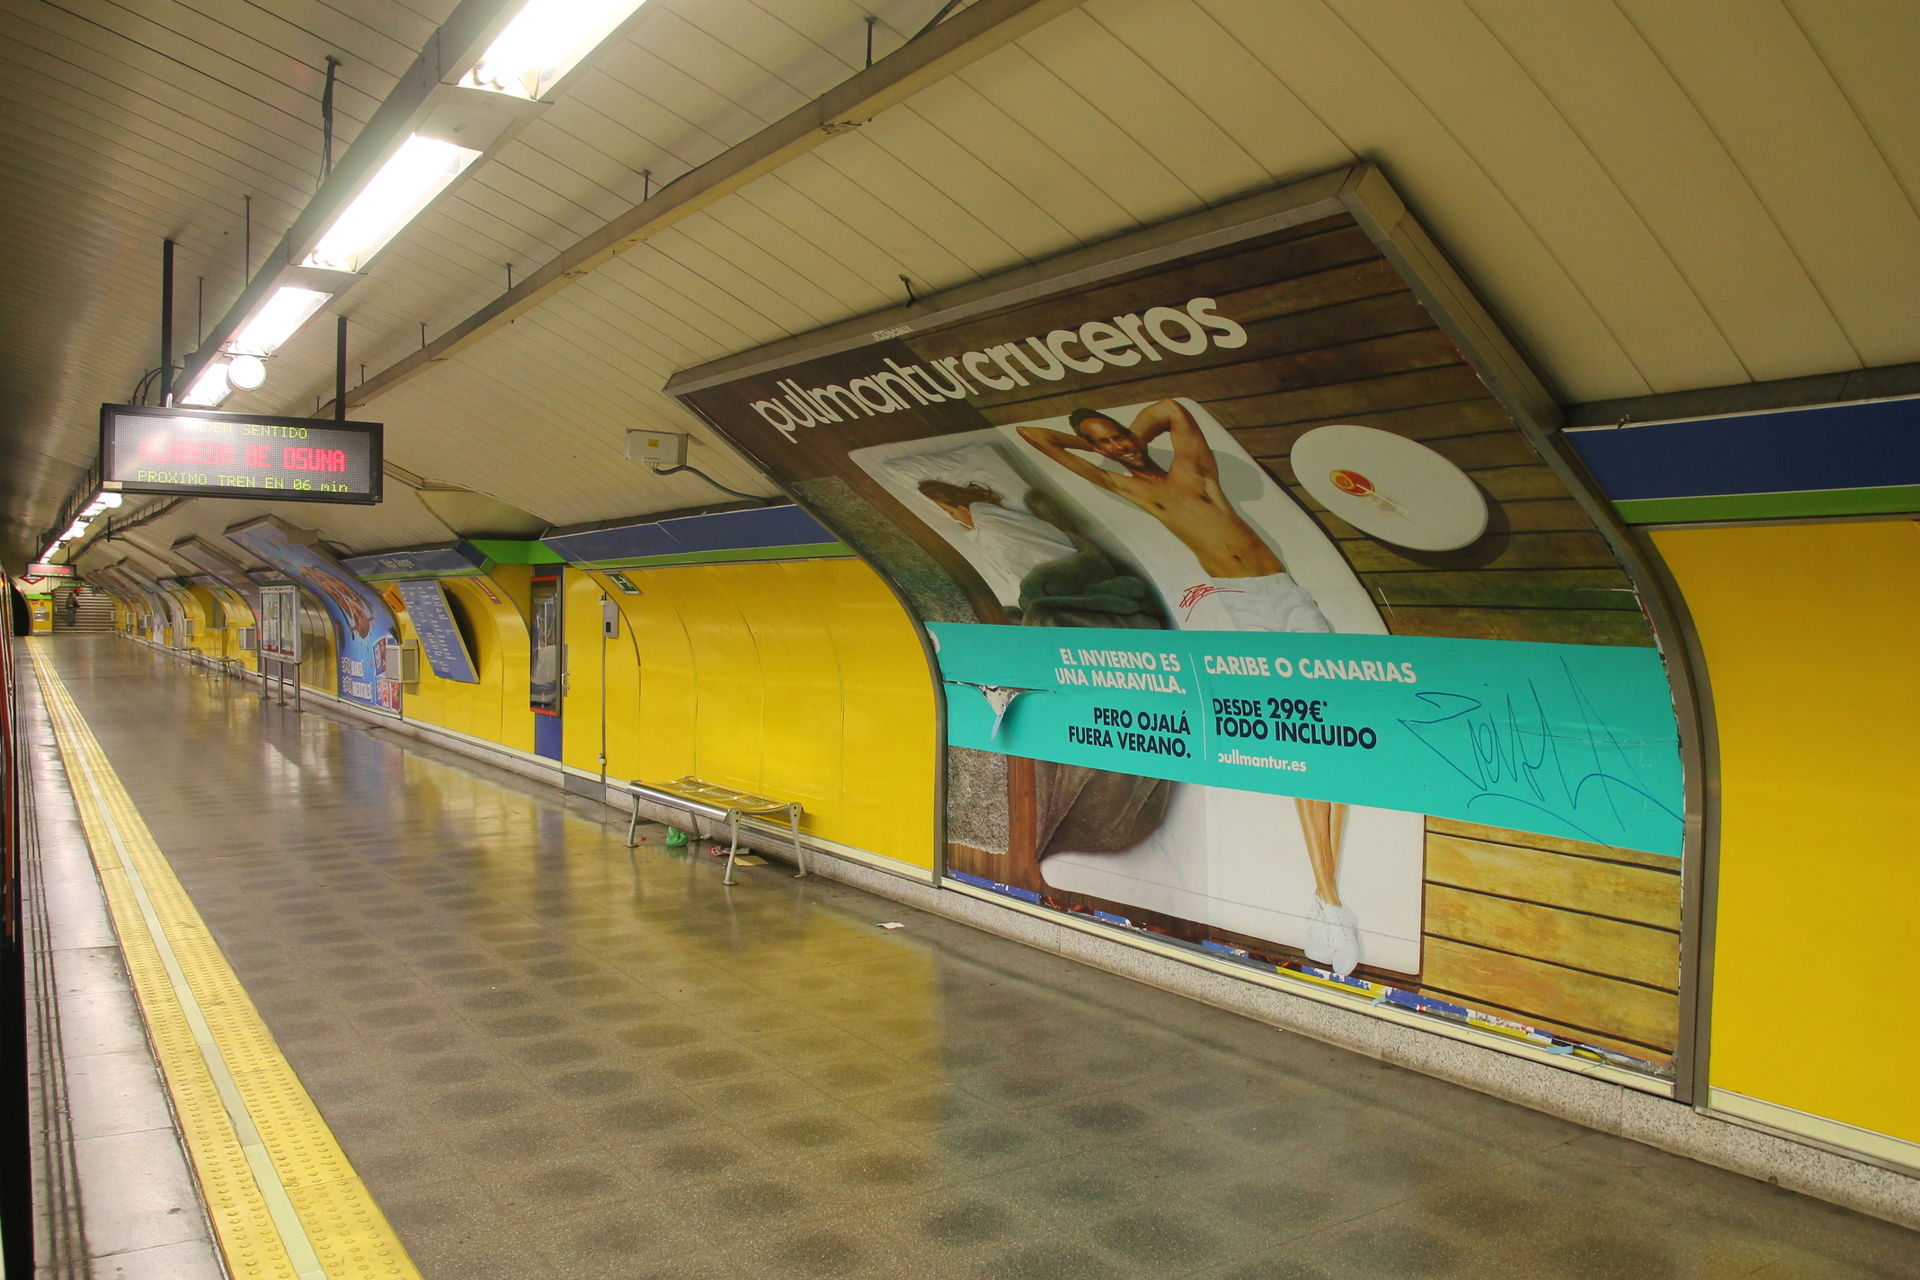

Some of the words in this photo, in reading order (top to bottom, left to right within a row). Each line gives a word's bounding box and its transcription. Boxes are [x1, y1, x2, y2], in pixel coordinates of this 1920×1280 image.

[242, 424, 308, 439] SENTIDO
[244, 444, 272, 468] DE
[283, 447, 347, 472] OSUNA
[137, 470, 208, 485] PROXIMO
[217, 475, 256, 489] TREN
[265, 477, 284, 490] EN
[293, 478, 312, 491] 06
[320, 480, 348, 493] min
[1059, 648, 1078, 666] EL
[1078, 649, 1157, 671] INVIERNO
[1159, 653, 1181, 672] ES
[1203, 655, 1271, 677] CARIBE
[1274, 657, 1293, 678] O
[1299, 658, 1417, 684] CANARIAS
[1054, 667, 1089, 686] UNA
[1092, 669, 1187, 694] MARAVILLA.
[1212, 697, 1262, 717] DESDE
[1093, 707, 1133, 729] PERO
[1137, 710, 1191, 735] OJALÁ
[1215, 717, 1268, 740] TODO
[1275, 721, 1377, 749] INCLUIDO
[1068, 725, 1113, 748] FUERA
[1117, 731, 1192, 758] VERANO.
